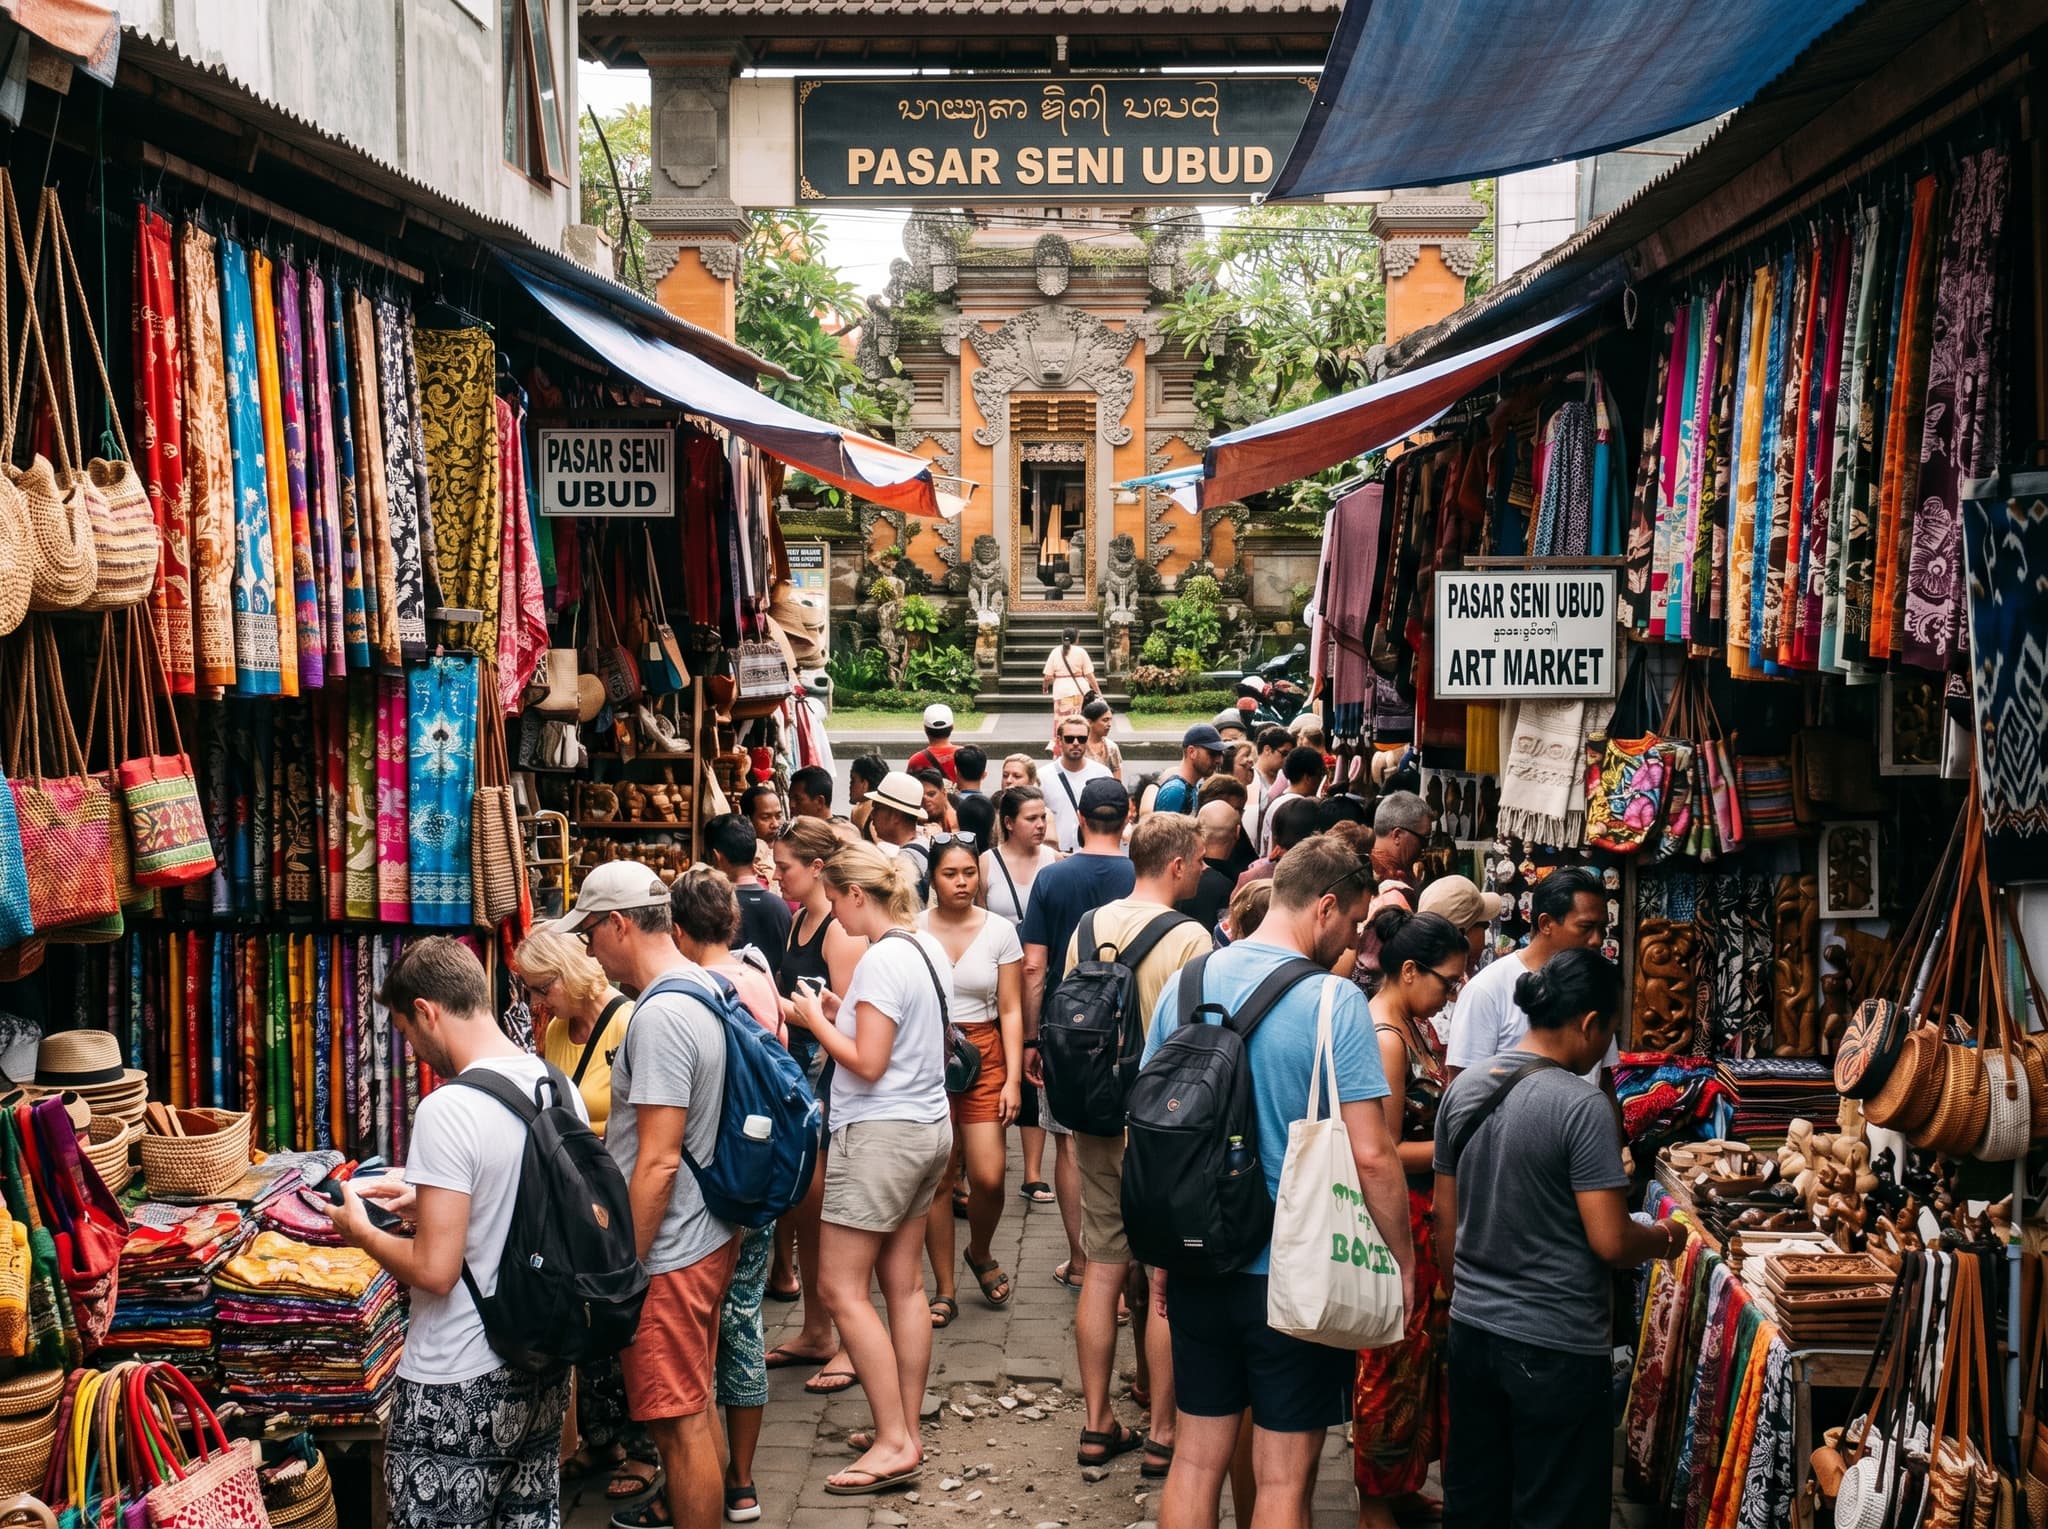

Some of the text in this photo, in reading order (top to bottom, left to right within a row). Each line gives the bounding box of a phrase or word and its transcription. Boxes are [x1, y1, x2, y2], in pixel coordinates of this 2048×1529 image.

[847, 146, 1274, 185] PASAR SENI UBUD
[547, 438, 666, 474] PASAR SENI
[557, 480, 658, 508] UBUD
[1448, 582, 1605, 619] PASAR SENI UBUD
[1447, 648, 1604, 686] ART MARKET
